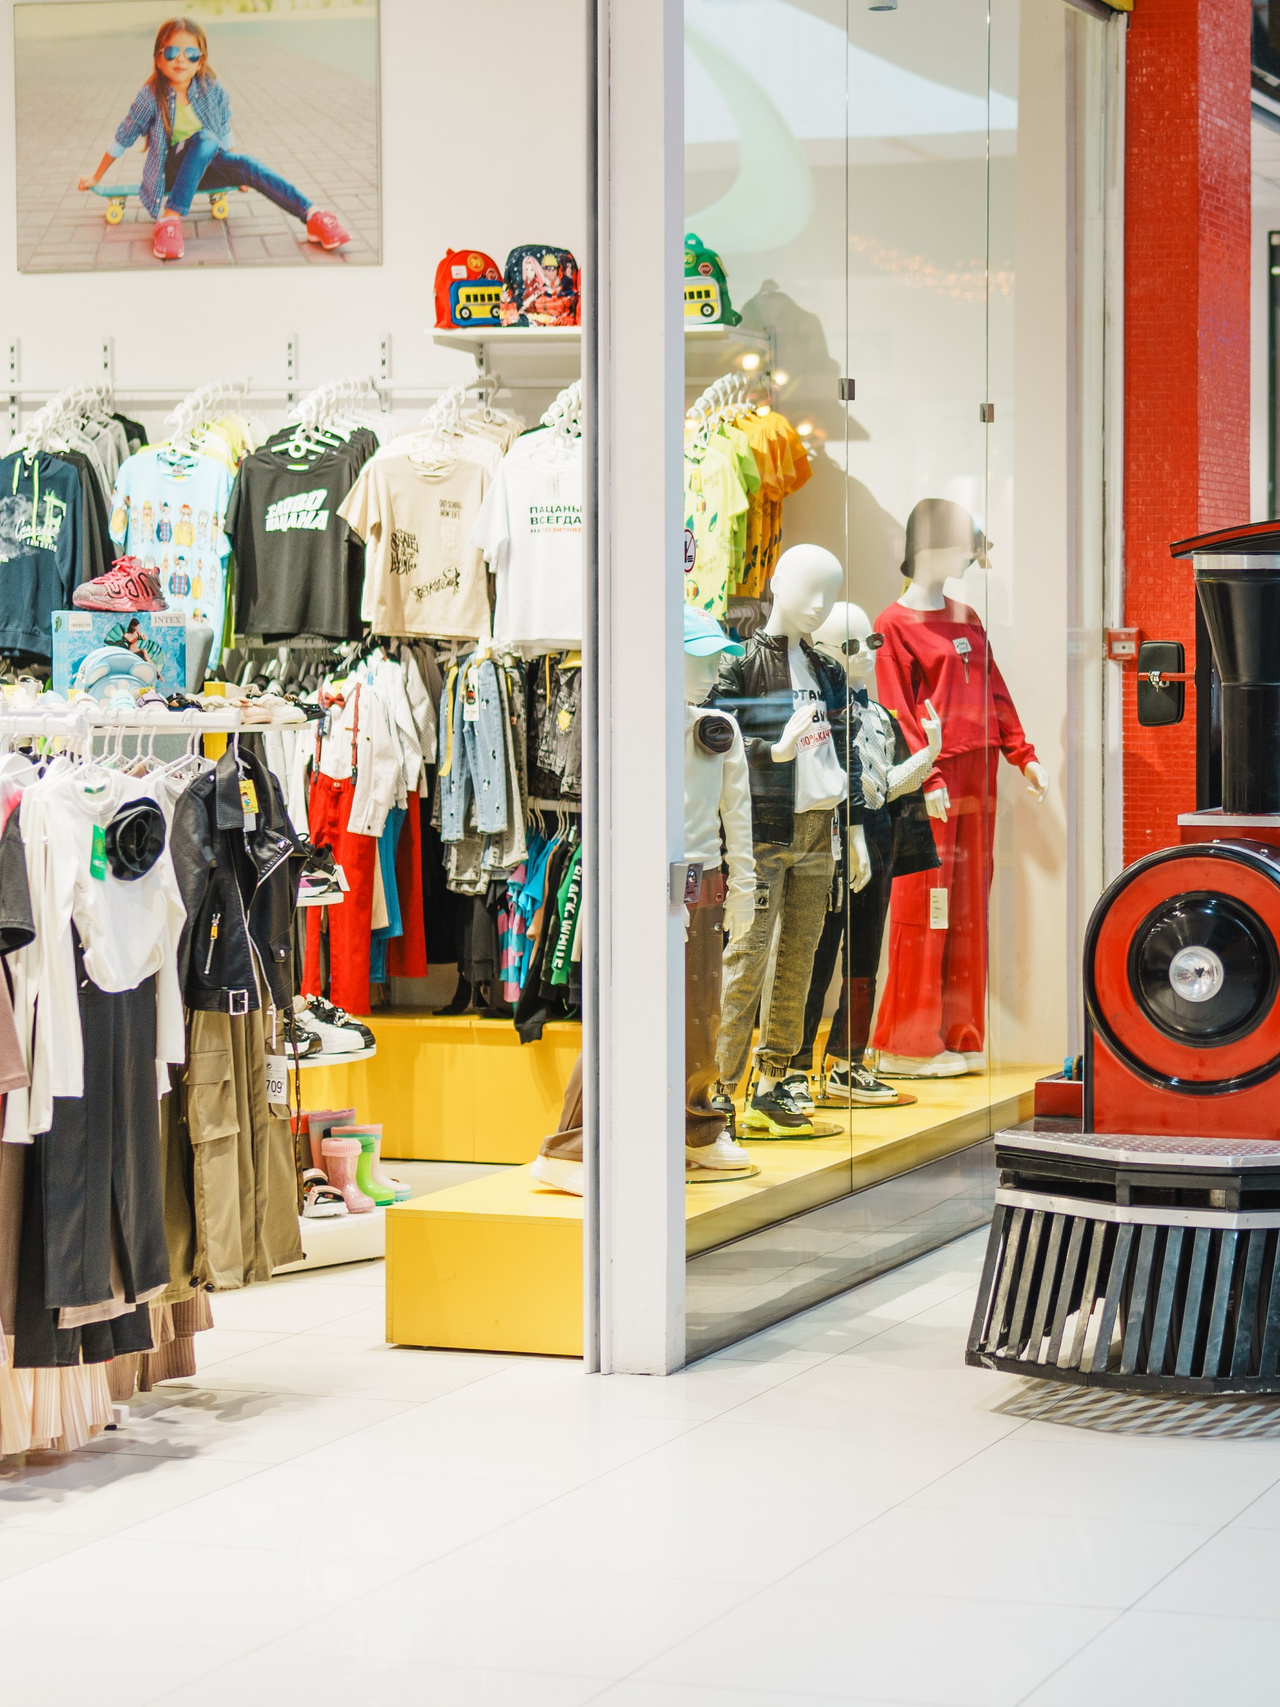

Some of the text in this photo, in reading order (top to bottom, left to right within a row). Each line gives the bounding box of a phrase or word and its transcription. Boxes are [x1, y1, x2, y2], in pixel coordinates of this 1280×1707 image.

[530, 505, 582, 514] ПАЦАНЫ
[530, 515, 582, 525] ВСЕГДА
[154, 616, 181, 624] INTEX
